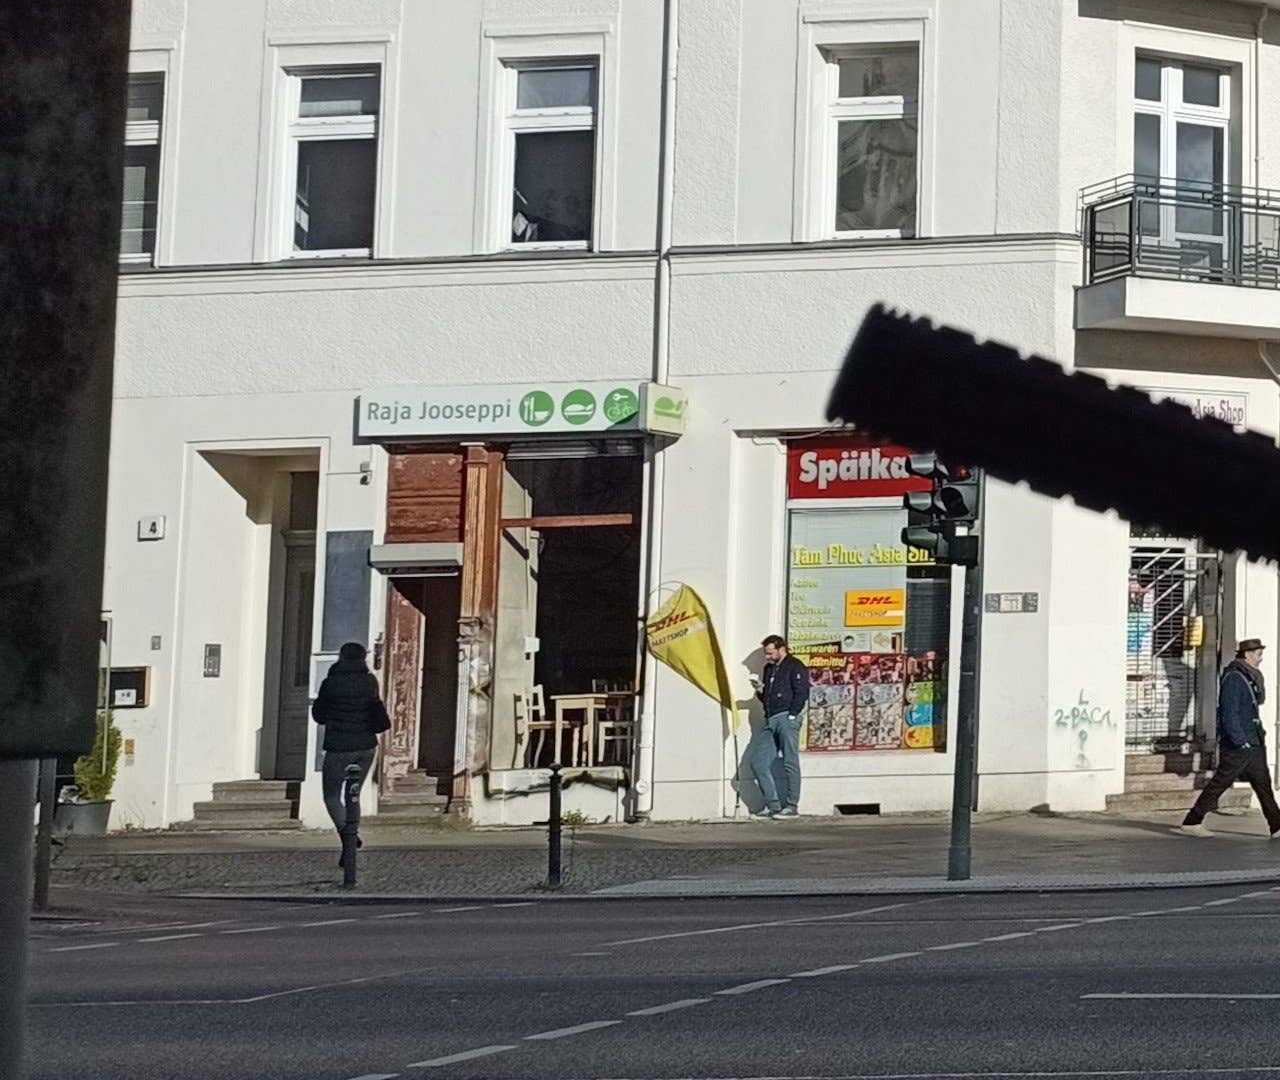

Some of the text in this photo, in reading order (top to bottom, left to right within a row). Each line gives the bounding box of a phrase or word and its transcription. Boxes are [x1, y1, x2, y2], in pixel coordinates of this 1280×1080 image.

[367, 398, 511, 424] Raja Jooseppi
[799, 448, 910, 490] Spätka
[149, 521, 157, 534] 4
[857, 596, 893, 605] DHL
[655, 611, 689, 632] DHL
